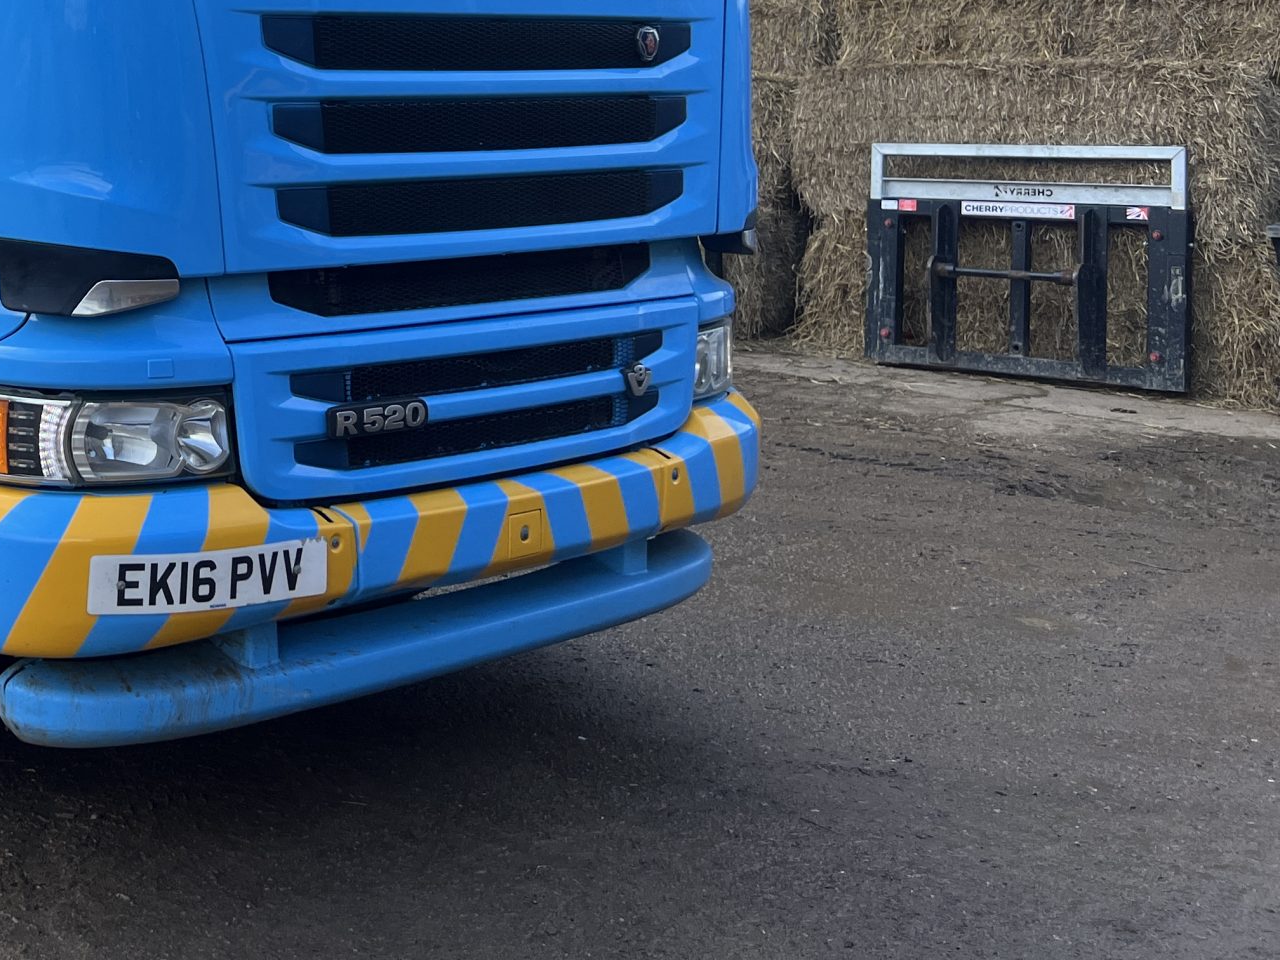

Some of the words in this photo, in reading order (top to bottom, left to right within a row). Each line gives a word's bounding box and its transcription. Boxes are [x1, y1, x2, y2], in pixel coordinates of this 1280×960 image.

[335, 410, 359, 437] R
[362, 402, 427, 433] 520
[116, 559, 218, 607] EK16
[229, 547, 304, 600] PVV
